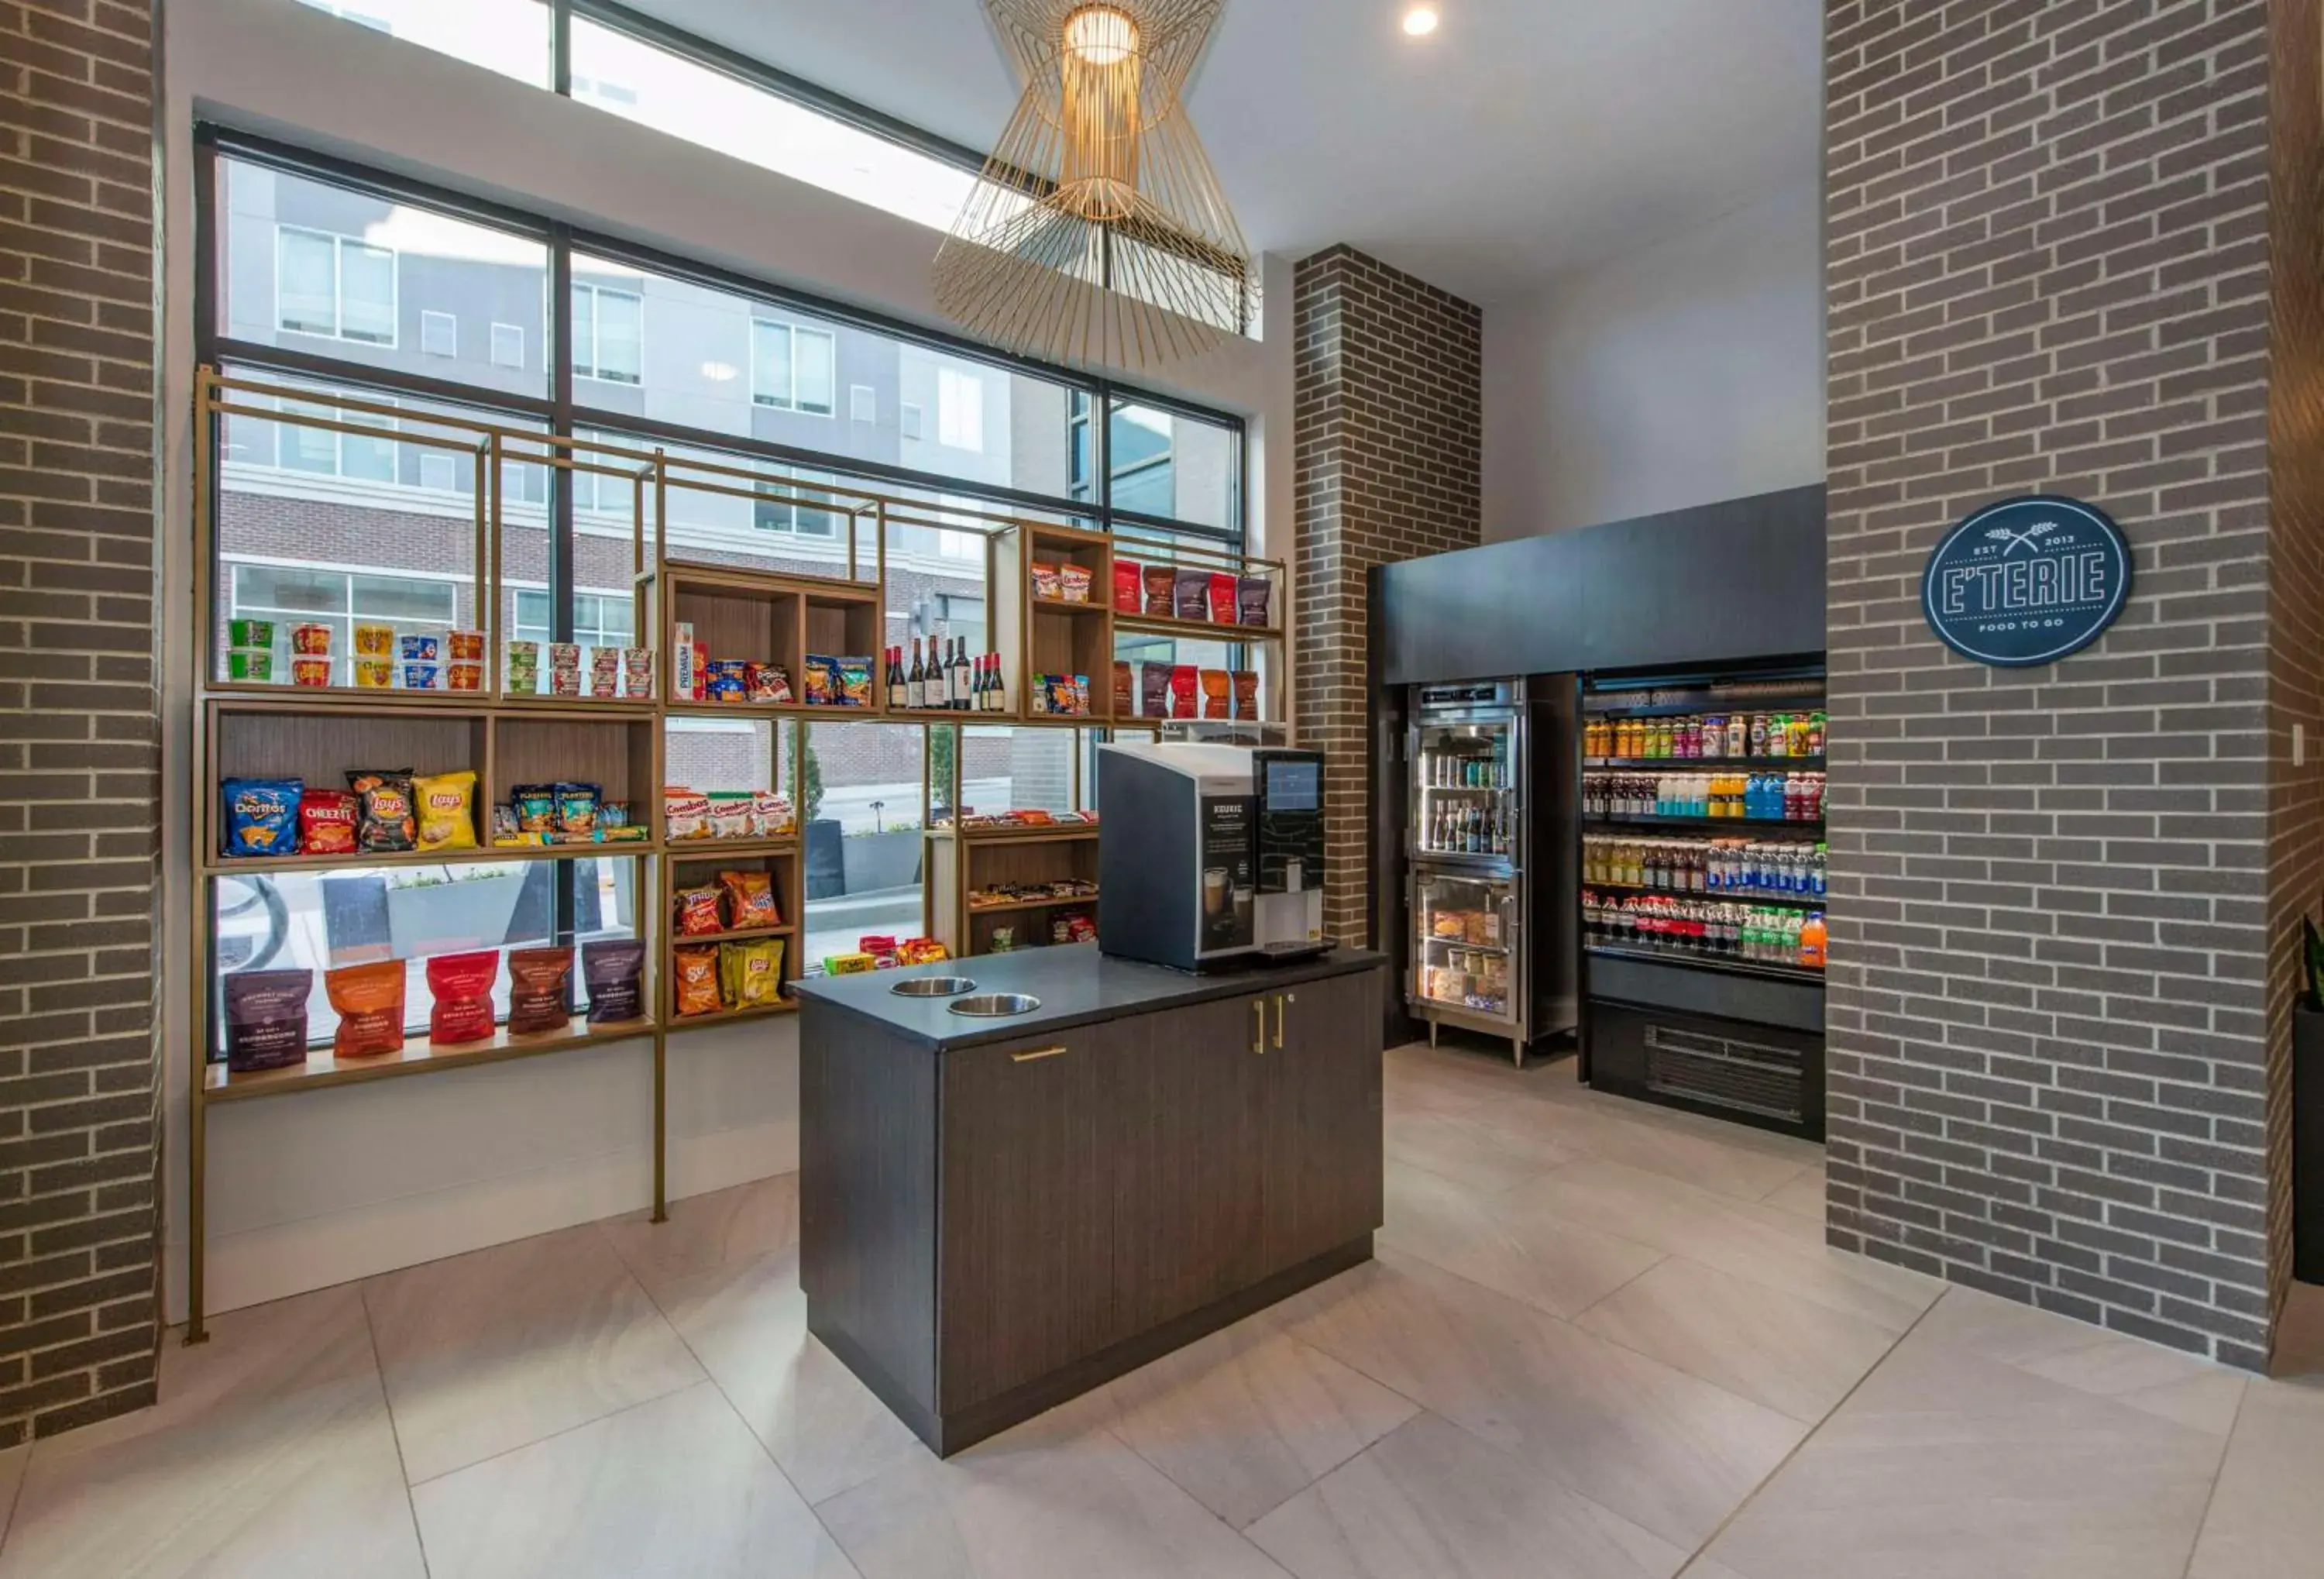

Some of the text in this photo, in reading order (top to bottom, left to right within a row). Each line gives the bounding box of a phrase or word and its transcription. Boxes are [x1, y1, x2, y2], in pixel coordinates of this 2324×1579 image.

[1973, 545, 1997, 556] EST
[1979, 617, 2064, 632] FOOD TO GO
[235, 803, 285, 814] Doritos
